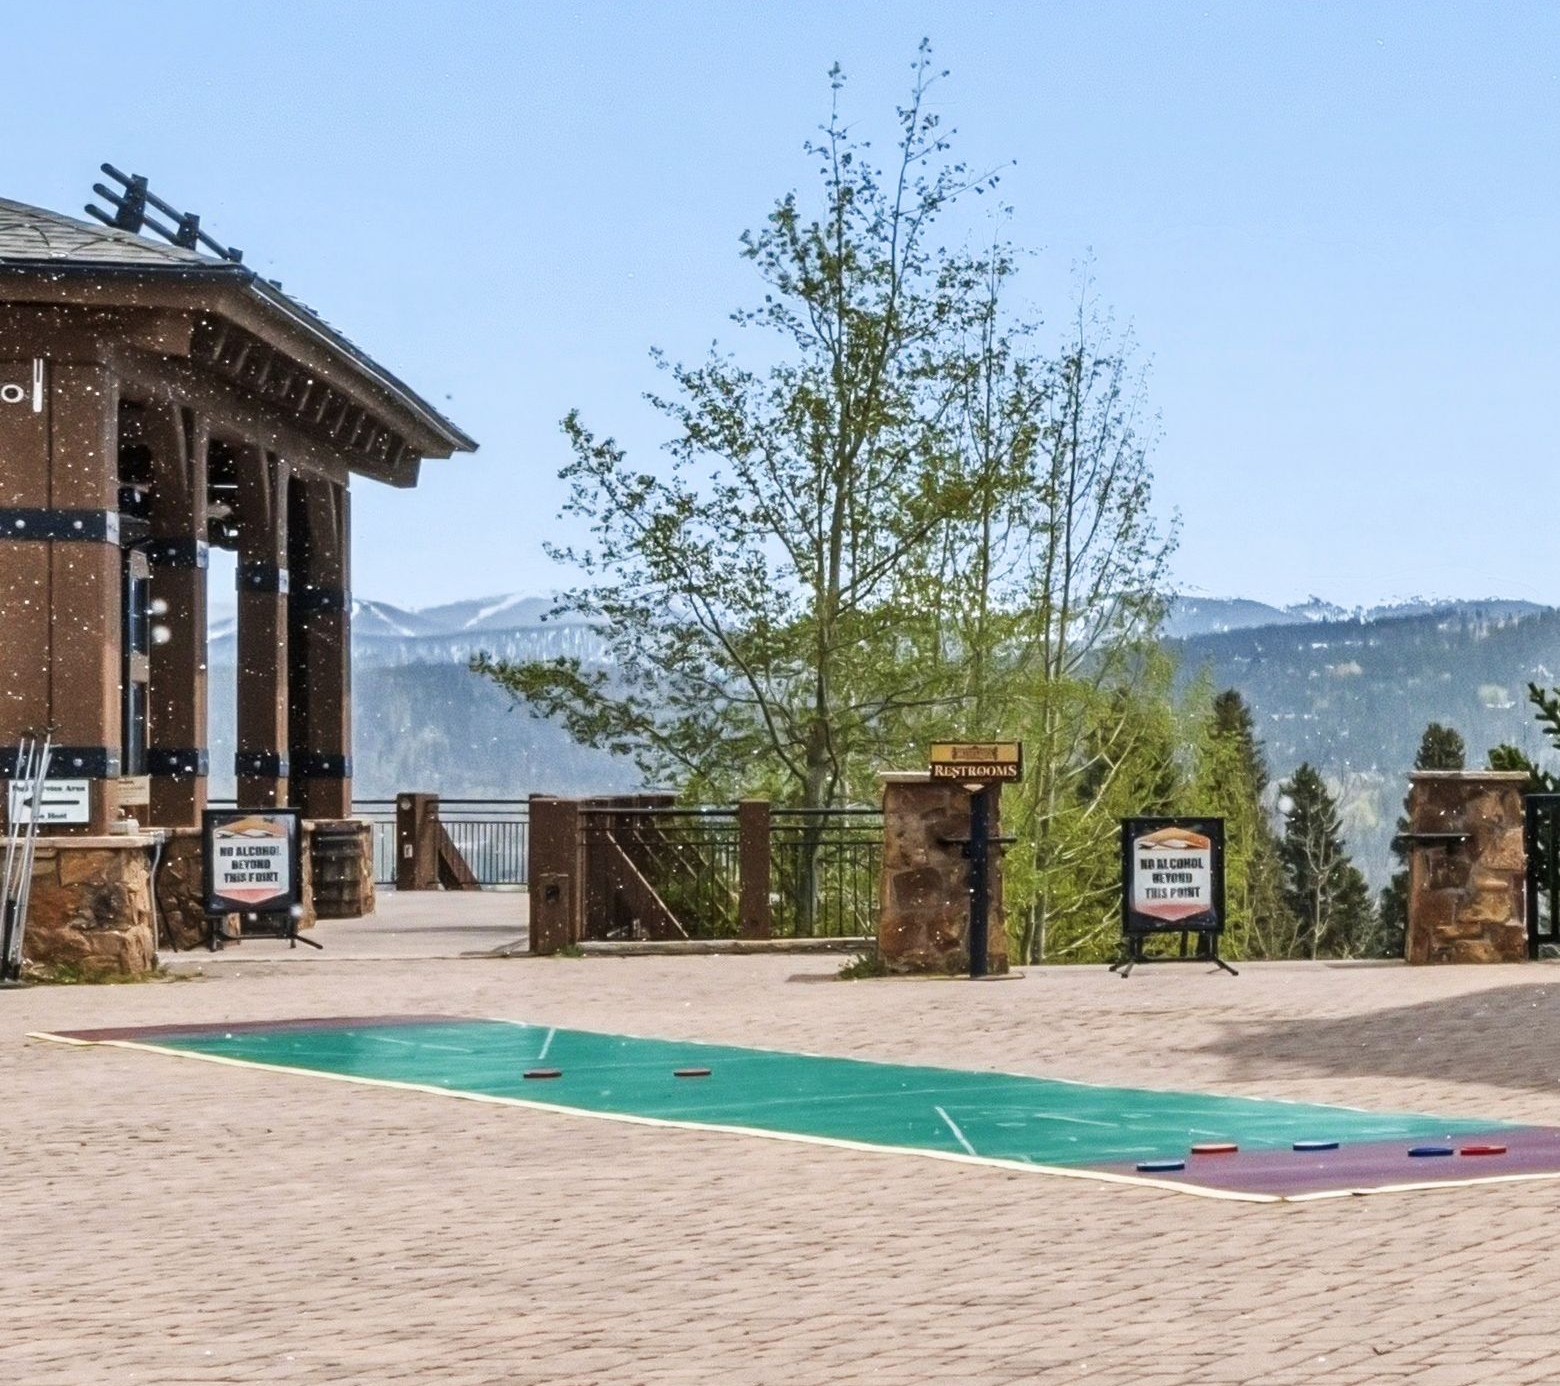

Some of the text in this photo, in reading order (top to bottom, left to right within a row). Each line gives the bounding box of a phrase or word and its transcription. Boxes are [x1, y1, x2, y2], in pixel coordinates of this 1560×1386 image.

[934, 765, 1017, 777] RESTROOMS
[220, 846, 281, 856] NO ALCOHOL
[231, 859, 271, 869] BEYOND
[1140, 858, 1203, 870] NO ALCOHOL
[224, 872, 278, 883] THIS POINT
[1152, 873, 1192, 883] BEYOND
[1145, 887, 1200, 899] THIS POINT
